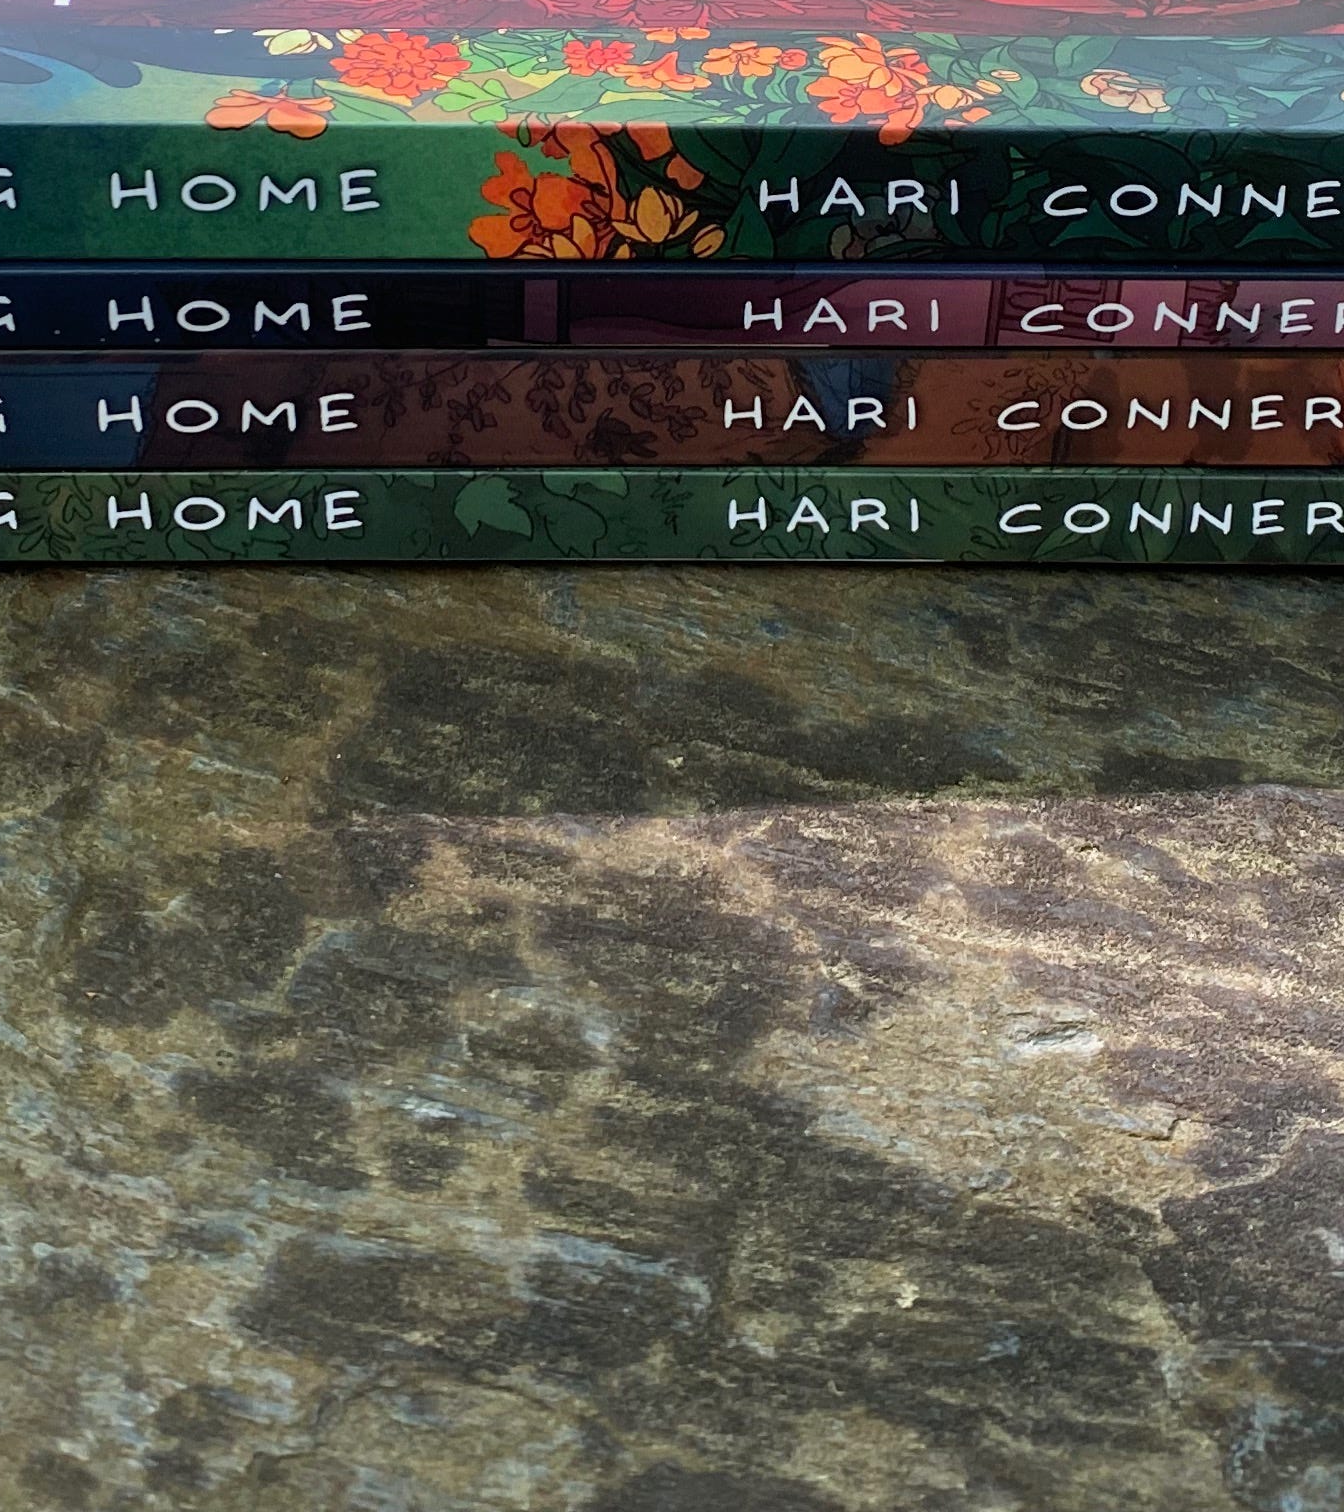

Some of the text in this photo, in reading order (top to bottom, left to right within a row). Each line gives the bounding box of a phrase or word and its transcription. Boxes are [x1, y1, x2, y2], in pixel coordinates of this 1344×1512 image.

[111, 169, 381, 212] HOME
[758, 176, 960, 217] HARI
[108, 294, 372, 333] HOME
[742, 296, 940, 334] HARI
[97, 393, 359, 434] HOME
[723, 394, 917, 433] HARI
[107, 489, 364, 532] HOME
[727, 495, 920, 534] HARI
